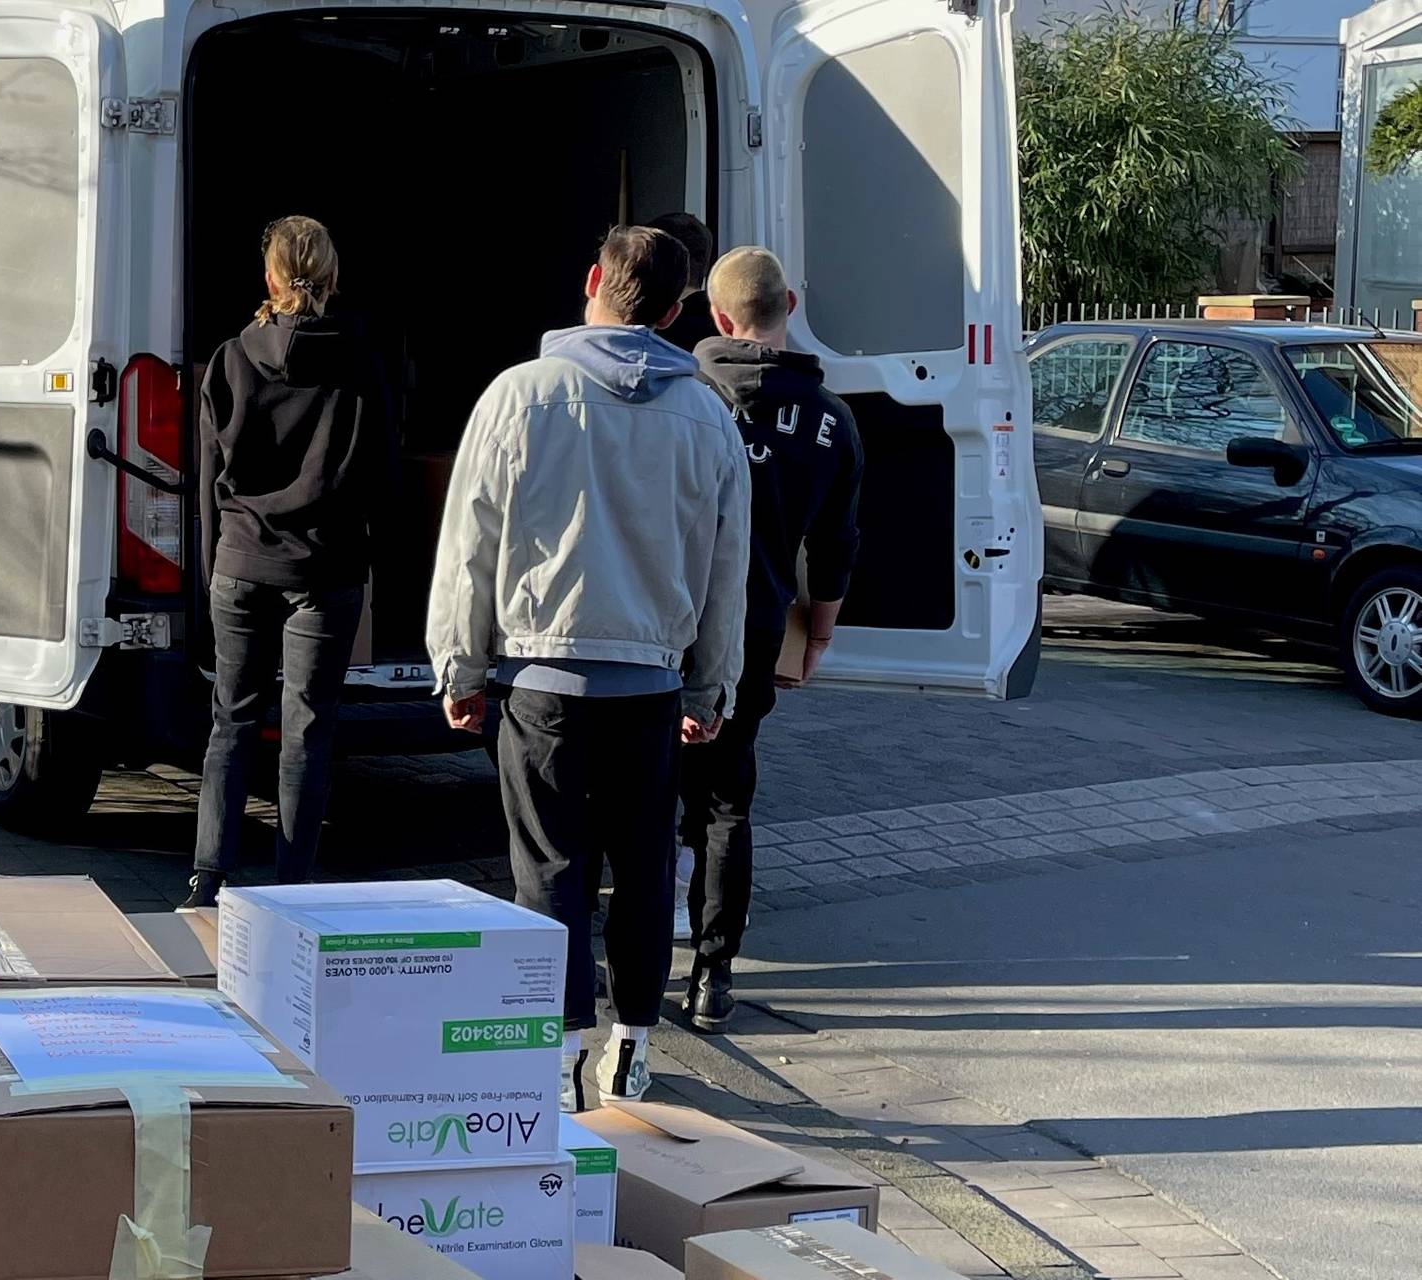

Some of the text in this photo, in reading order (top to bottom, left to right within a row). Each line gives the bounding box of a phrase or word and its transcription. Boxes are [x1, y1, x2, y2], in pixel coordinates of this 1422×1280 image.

[325, 957, 350, 966] EACH)
[352, 956, 384, 965] GLOVES
[384, 956, 398, 964] 100
[401, 955, 412, 963] OF
[414, 954, 439, 963] BOXES
[325, 964, 453, 977] QUANTITY: 1,000 GLOVES
[450, 1021, 558, 1043] S N923402
[365, 1094, 424, 1104] Examination
[427, 1092, 454, 1102] Nitrile
[457, 1092, 478, 1101] Soft
[481, 1091, 543, 1101] Powder-Free
[387, 1112, 541, 1155] AloeVate
[576, 1208, 604, 1217] Gloves
[436, 1238, 563, 1253] Nitrile Examination Gloves
